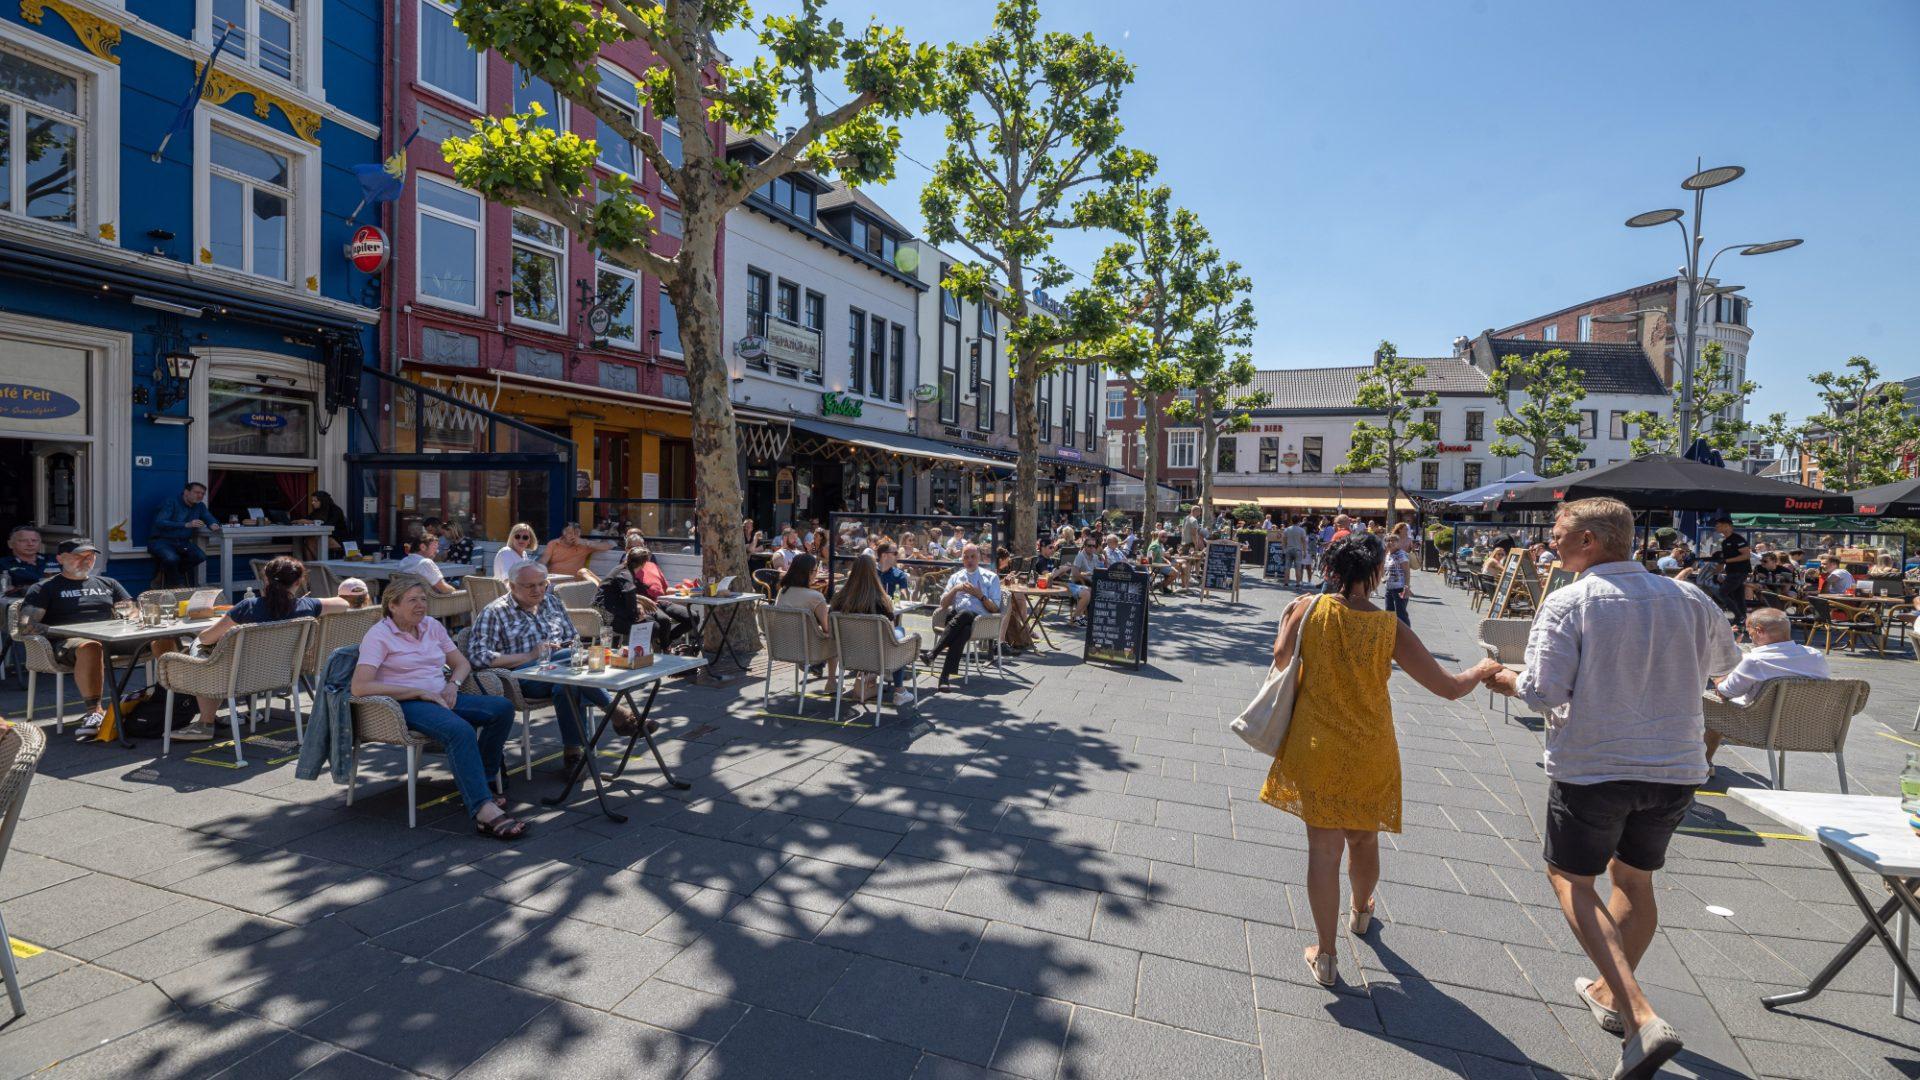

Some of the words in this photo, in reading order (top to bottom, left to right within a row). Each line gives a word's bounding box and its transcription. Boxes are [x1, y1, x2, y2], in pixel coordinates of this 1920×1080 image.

[0, 386, 18, 399] afé
[23, 389, 51, 401] Pelt
[822, 391, 864, 418] Grolsch
[1264, 424, 1284, 433] BIER
[1784, 497, 1824, 510] Duvel
[1859, 505, 1878, 513] Duvel
